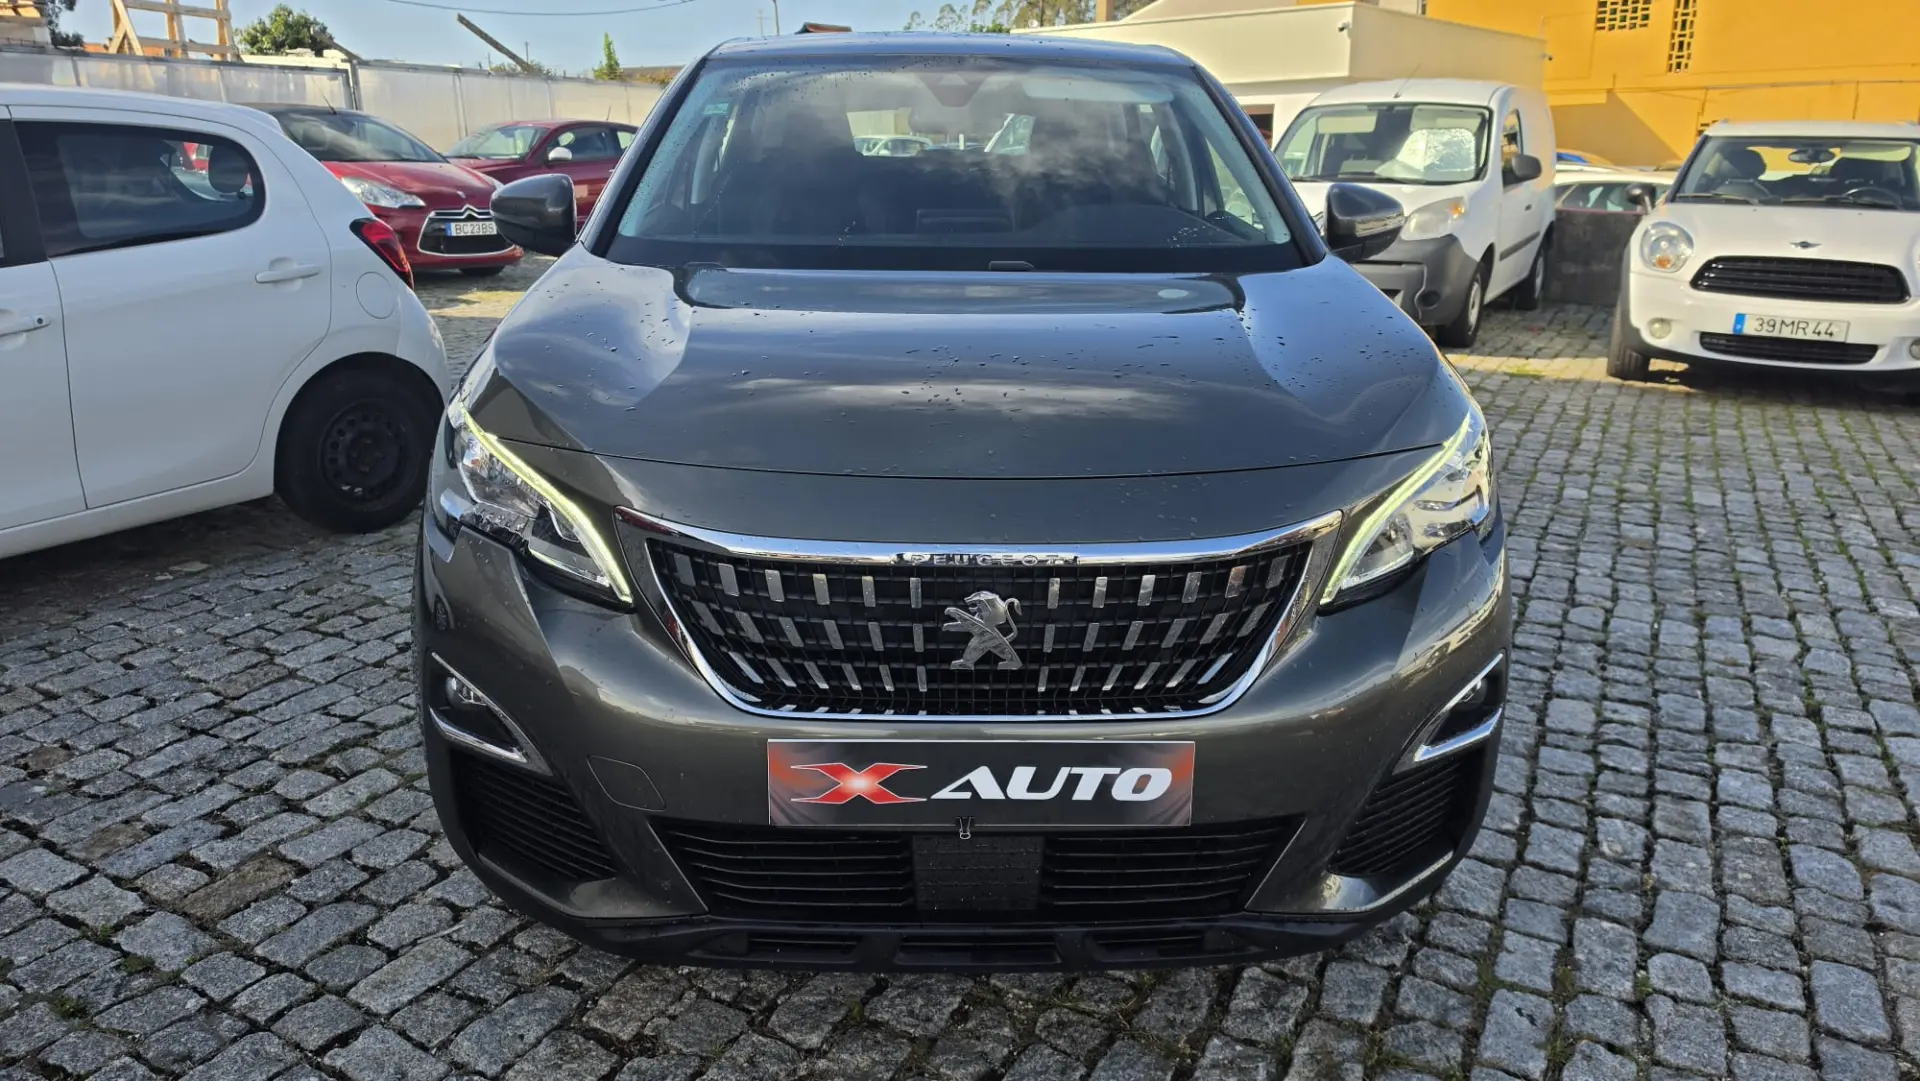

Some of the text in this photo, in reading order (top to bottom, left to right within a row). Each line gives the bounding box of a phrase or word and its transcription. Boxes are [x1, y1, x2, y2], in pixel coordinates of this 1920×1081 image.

[910, 553, 1064, 567] PEUGEOT
[790, 762, 1173, 804] X AUTO
